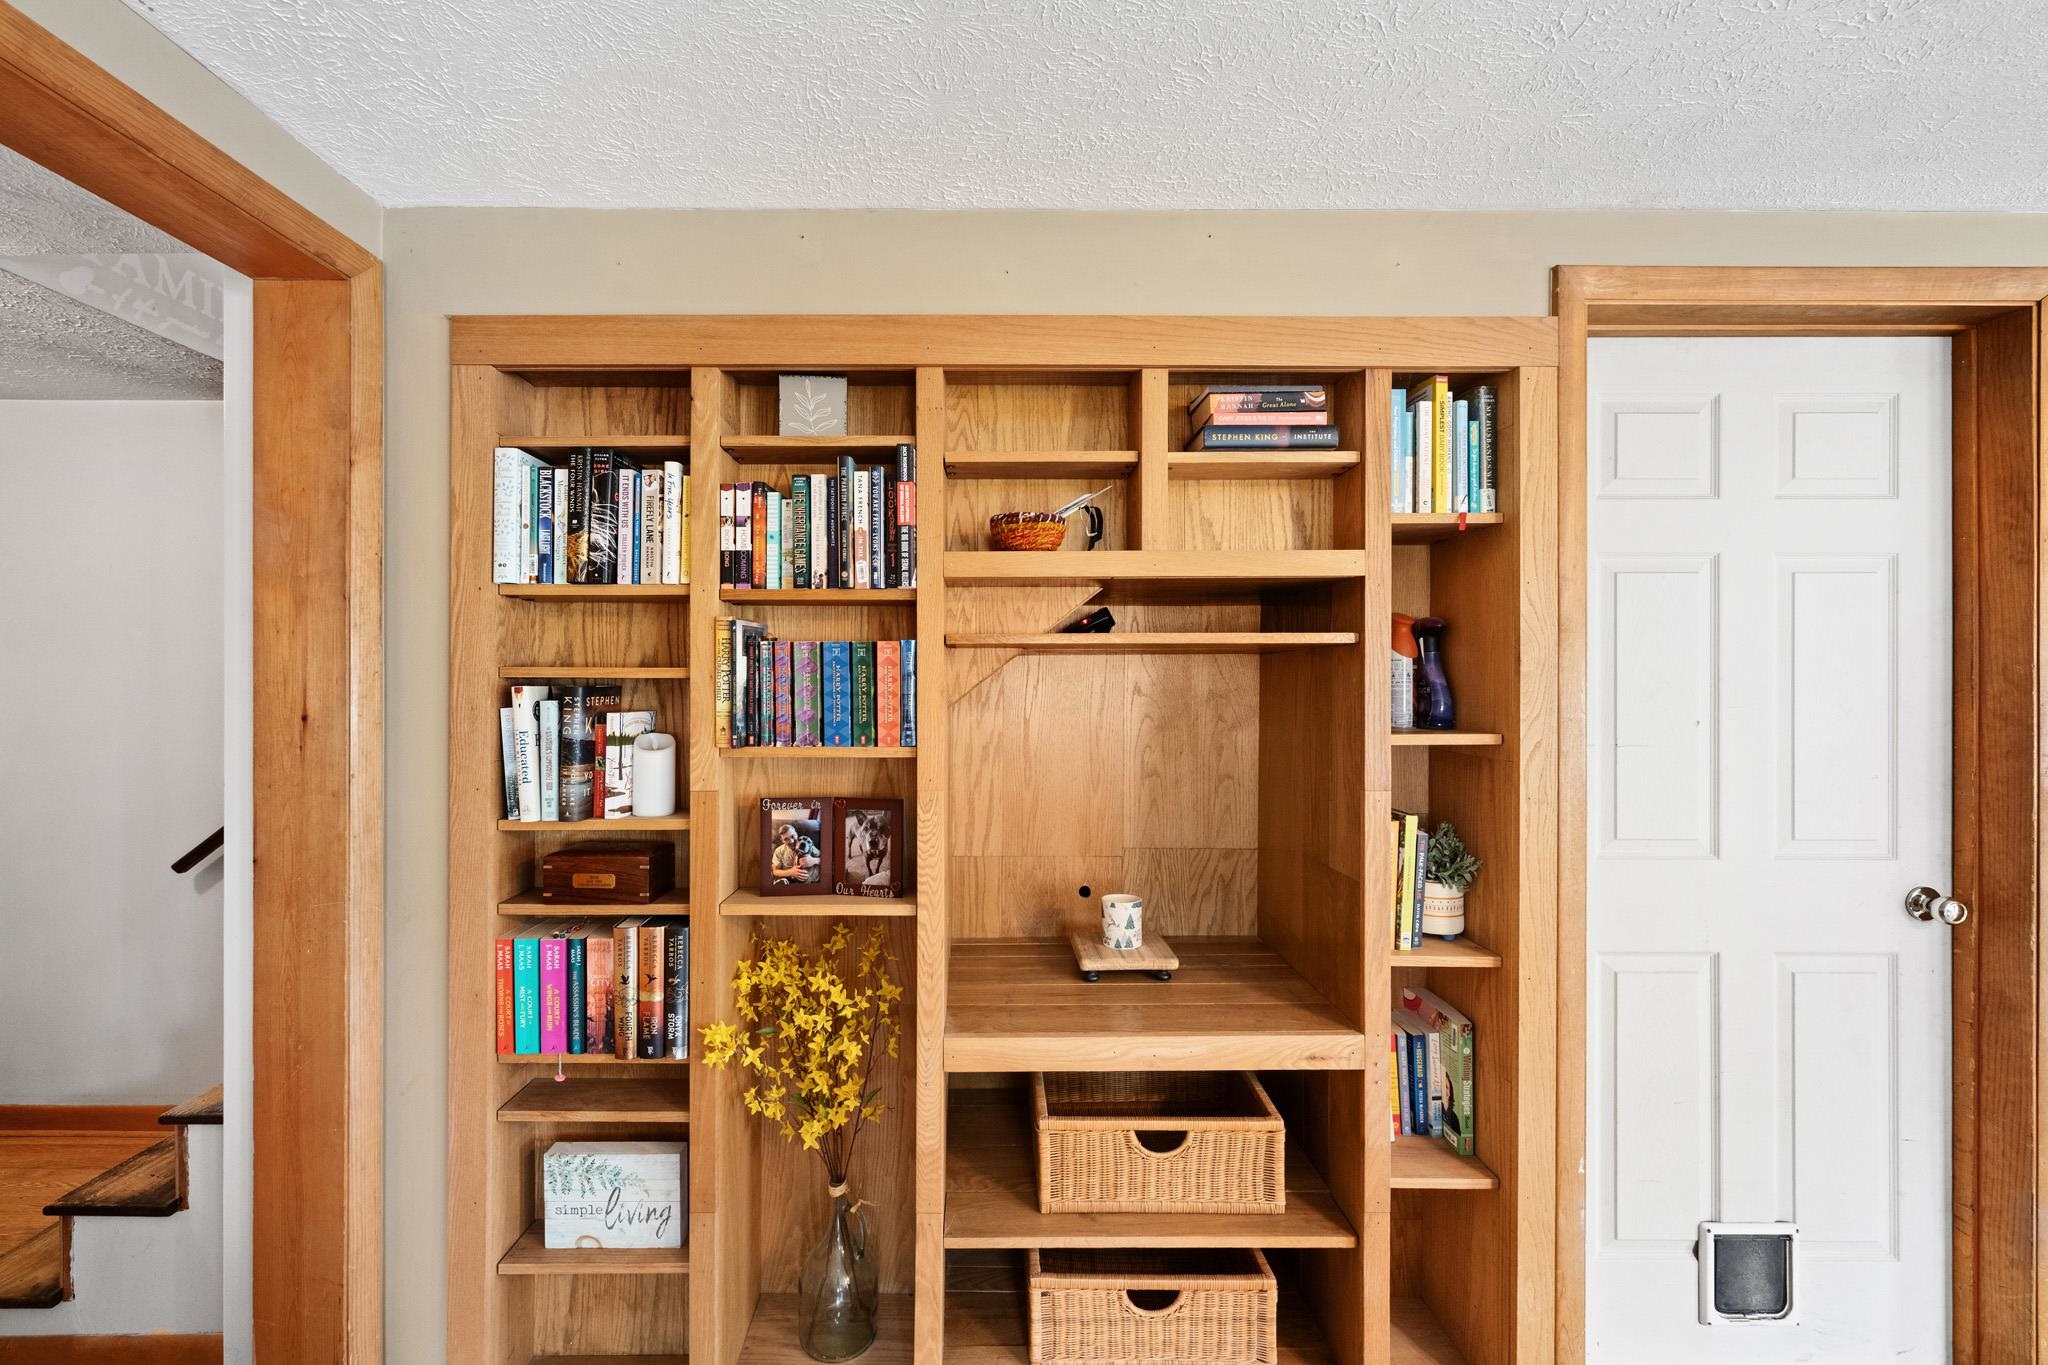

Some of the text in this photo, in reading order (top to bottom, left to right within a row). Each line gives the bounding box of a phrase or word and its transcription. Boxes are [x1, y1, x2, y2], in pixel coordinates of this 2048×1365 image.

[1486, 405, 1492, 417] MY
[539, 470, 552, 519] BLACKSTOCK
[621, 483, 629, 501] ENDS
[667, 480, 676, 495] Five
[794, 490, 807, 503] THE
[621, 501, 629, 519] WITH
[645, 495, 654, 544] FIREFLY LANE
[665, 498, 675, 520] Years
[872, 485, 880, 552] YOU ARE FREE LYONS
[621, 520, 629, 529] US
[794, 503, 807, 547] INHERITANCE
[901, 526, 909, 534] THE
[901, 541, 909, 552] BOOK
[794, 548, 807, 573] GAMES
[901, 558, 909, 571] SERIAL
[721, 637, 731, 704] HARRY POTTER
[586, 696, 620, 707] STEPHEN
[563, 696, 573, 735] KING
[573, 696, 582, 736] STEPHEN
[519, 730, 532, 785] Educated
[762, 799, 822, 811] Forever in
[1417, 852, 1425, 889] PALE-FACED
[836, 882, 895, 898] Our Hearts
[590, 979, 610, 987] CITY
[572, 980, 580, 1018] ASSASSIN'S
[572, 1019, 580, 1040] BLADE
[625, 1012, 633, 1041] FOURTH
[642, 1012, 650, 1040] FLAME
[650, 1016, 658, 1035] IRON
[667, 1013, 675, 1040] STORM
[674, 1015, 683, 1038] ONYX
[1416, 1048, 1424, 1078] HOUSEMAID
[1461, 1055, 1472, 1115] Writing Strategies
[555, 1187, 672, 1240] simple living
